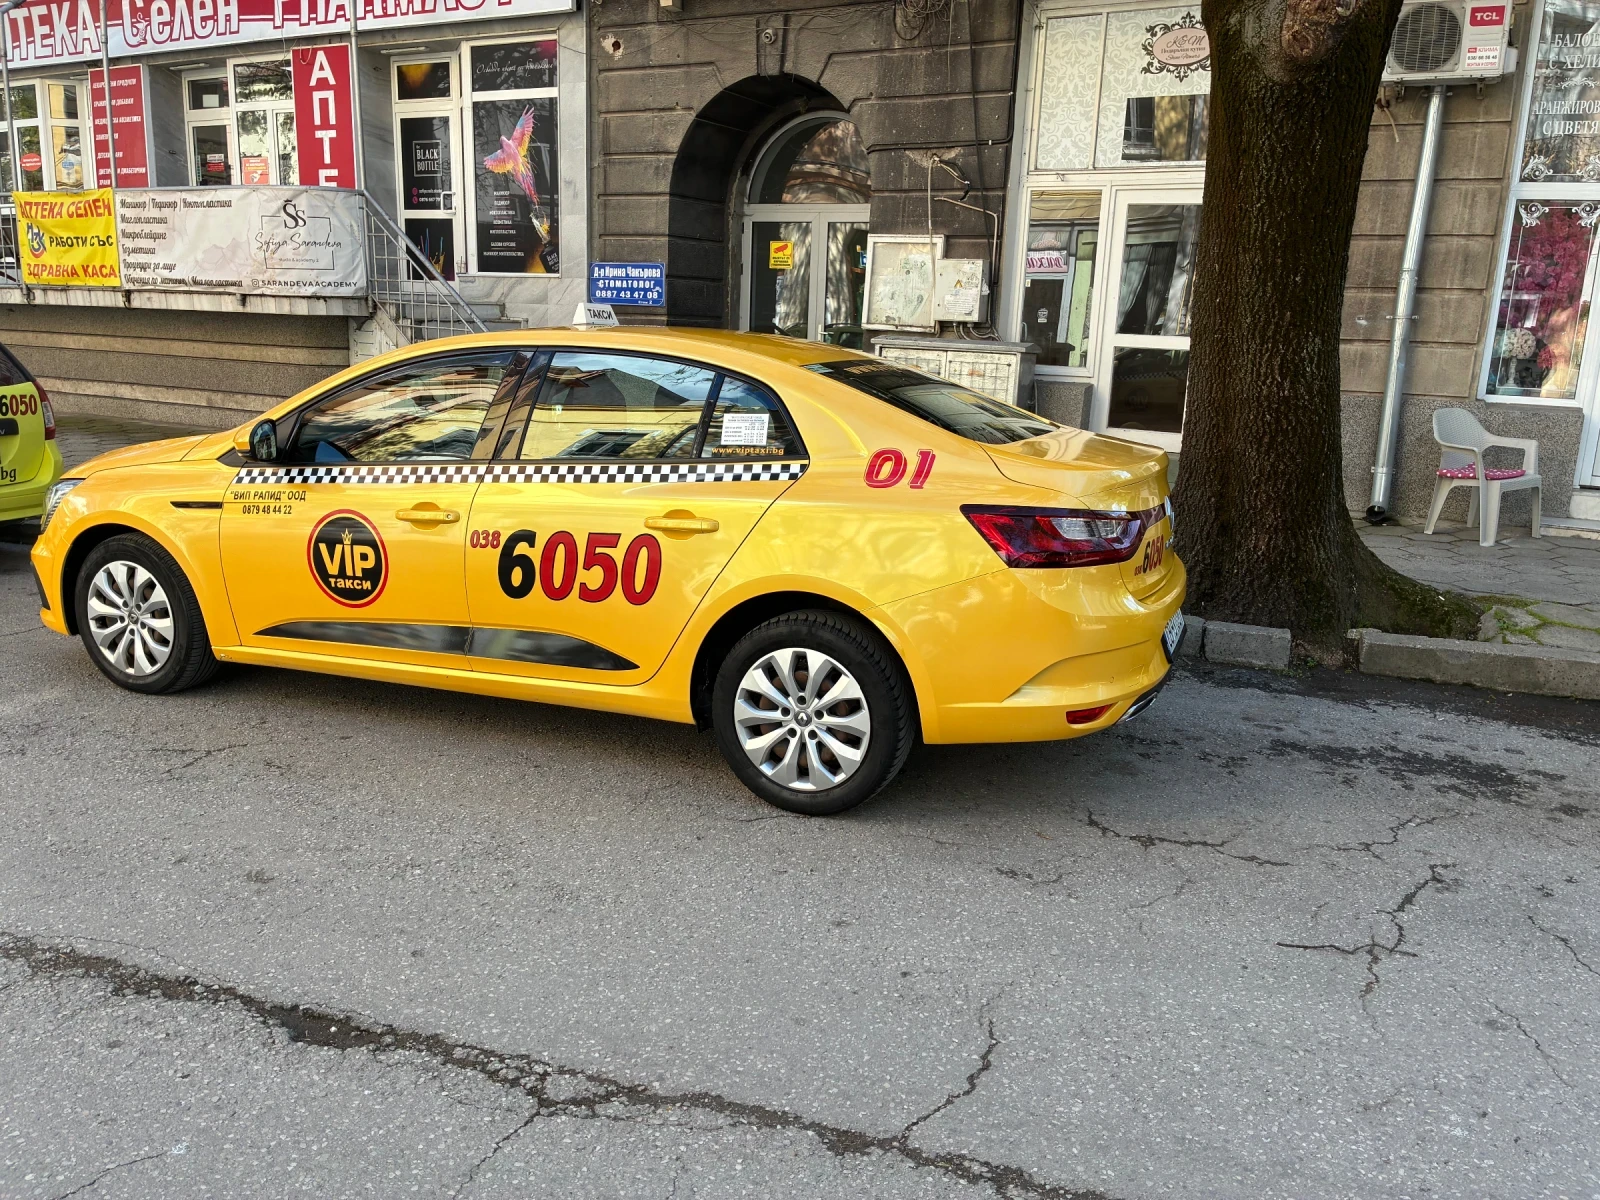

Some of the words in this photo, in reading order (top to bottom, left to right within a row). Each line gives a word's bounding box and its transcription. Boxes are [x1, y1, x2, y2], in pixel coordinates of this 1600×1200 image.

[1475, 12, 1500, 20] TCL
[416, 149, 439, 159] BLACK
[417, 160, 440, 171] BOTTLE
[20, 201, 63, 220] АПТЕКА
[66, 198, 112, 219] СЕЛЕН
[49, 236, 88, 248] РАБОТИ
[89, 235, 114, 247] СЪС
[26, 263, 80, 279] ЗДРАВНА
[81, 264, 118, 278] КАСА
[593, 266, 604, 277] Д-р
[605, 266, 626, 278] Ирина
[627, 266, 660, 279] Чакърова
[598, 280, 654, 289] СТОМАТОЛОГ
[595, 290, 617, 298] 0887
[647, 291, 658, 299] 08
[587, 308, 614, 320] ТАКСИ
[711, 446, 784, 456] www.viptaxi.bg
[863, 447, 936, 489] 01
[287, 491, 306, 502] ООД
[242, 504, 260, 515] 0879
[261, 504, 271, 514] 48
[272, 504, 282, 514] 44
[283, 504, 292, 514] 22
[318, 543, 376, 577] VIP
[1143, 535, 1164, 573] 6050
[470, 530, 501, 549] 038
[498, 529, 662, 606] 6050
[329, 578, 372, 590] такси
